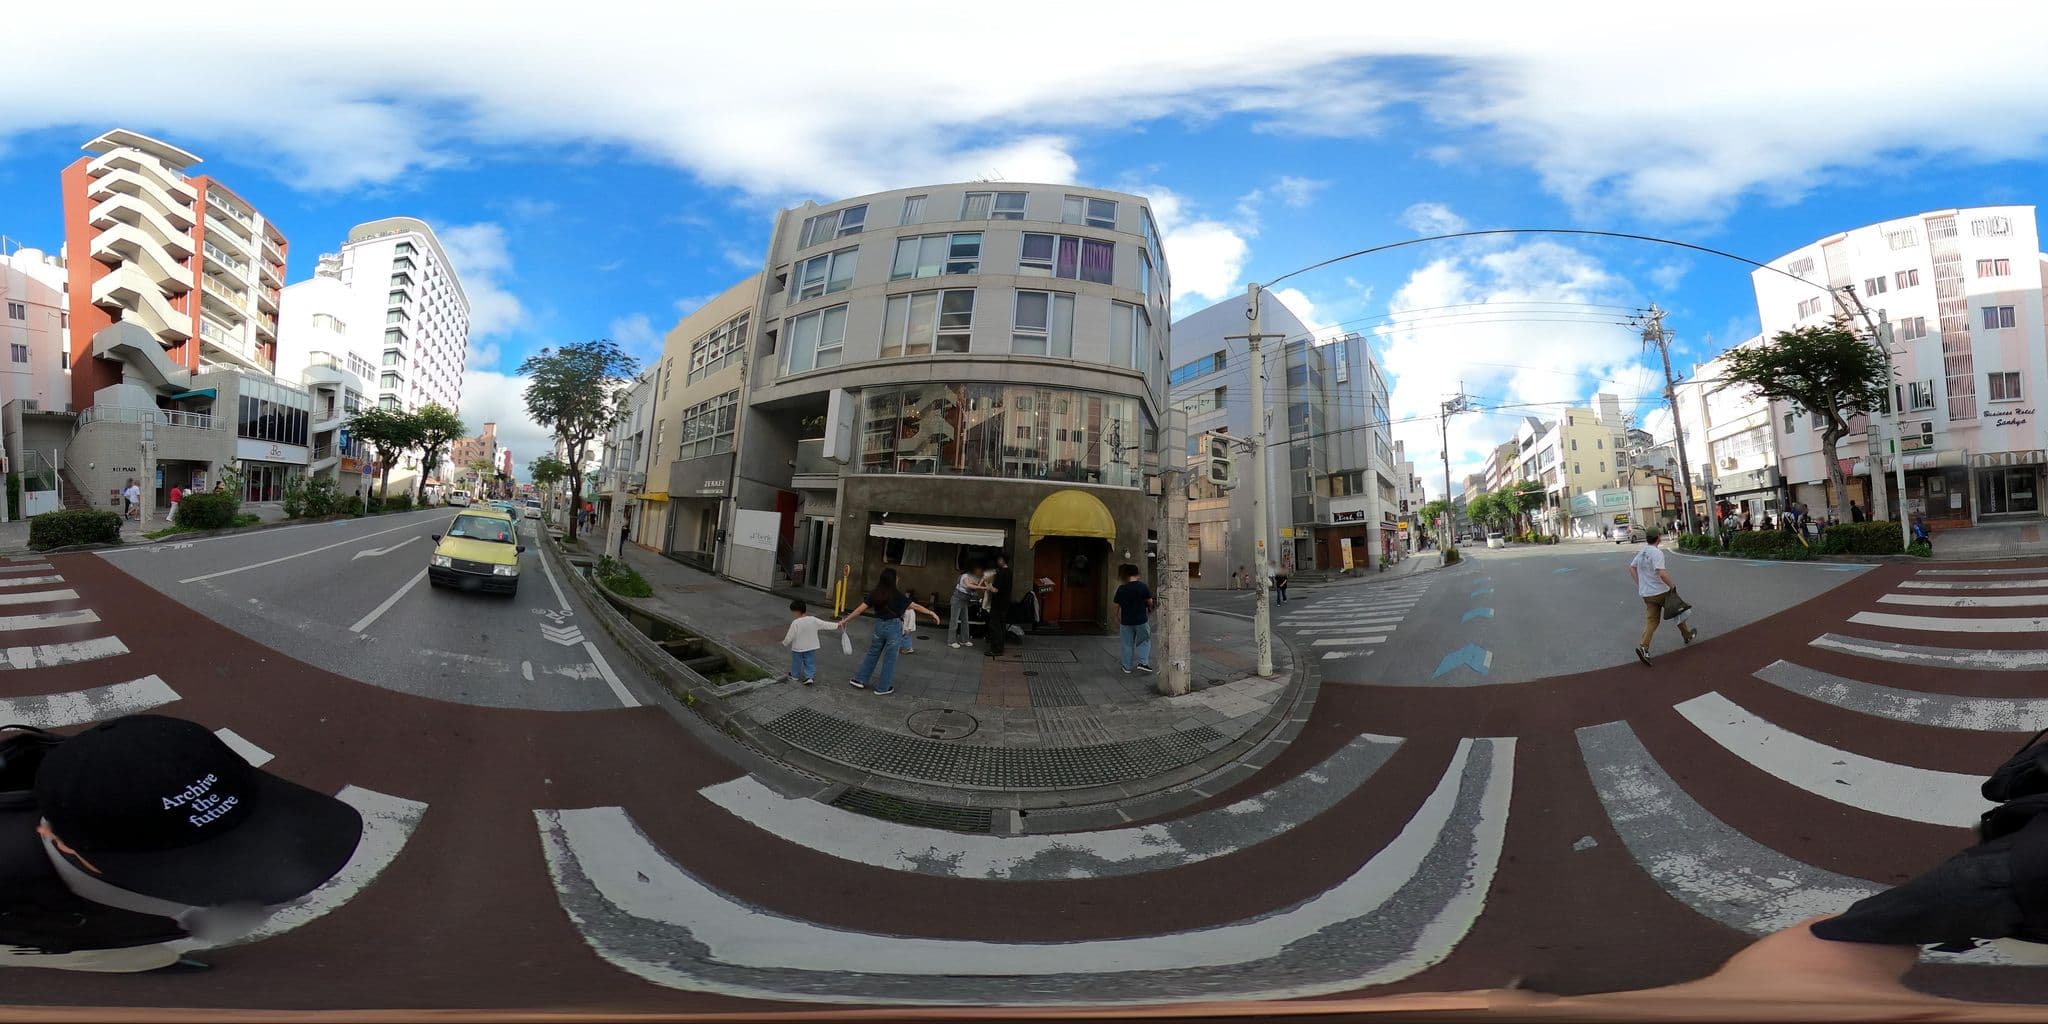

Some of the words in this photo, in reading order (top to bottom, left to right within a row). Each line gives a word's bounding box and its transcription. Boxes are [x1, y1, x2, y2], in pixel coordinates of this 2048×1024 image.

[1983, 410, 2013, 418] Business
[2015, 408, 2036, 416] Hotel
[162, 773, 218, 810] Archive
[192, 794, 220, 812] the
[189, 796, 239, 827] future
